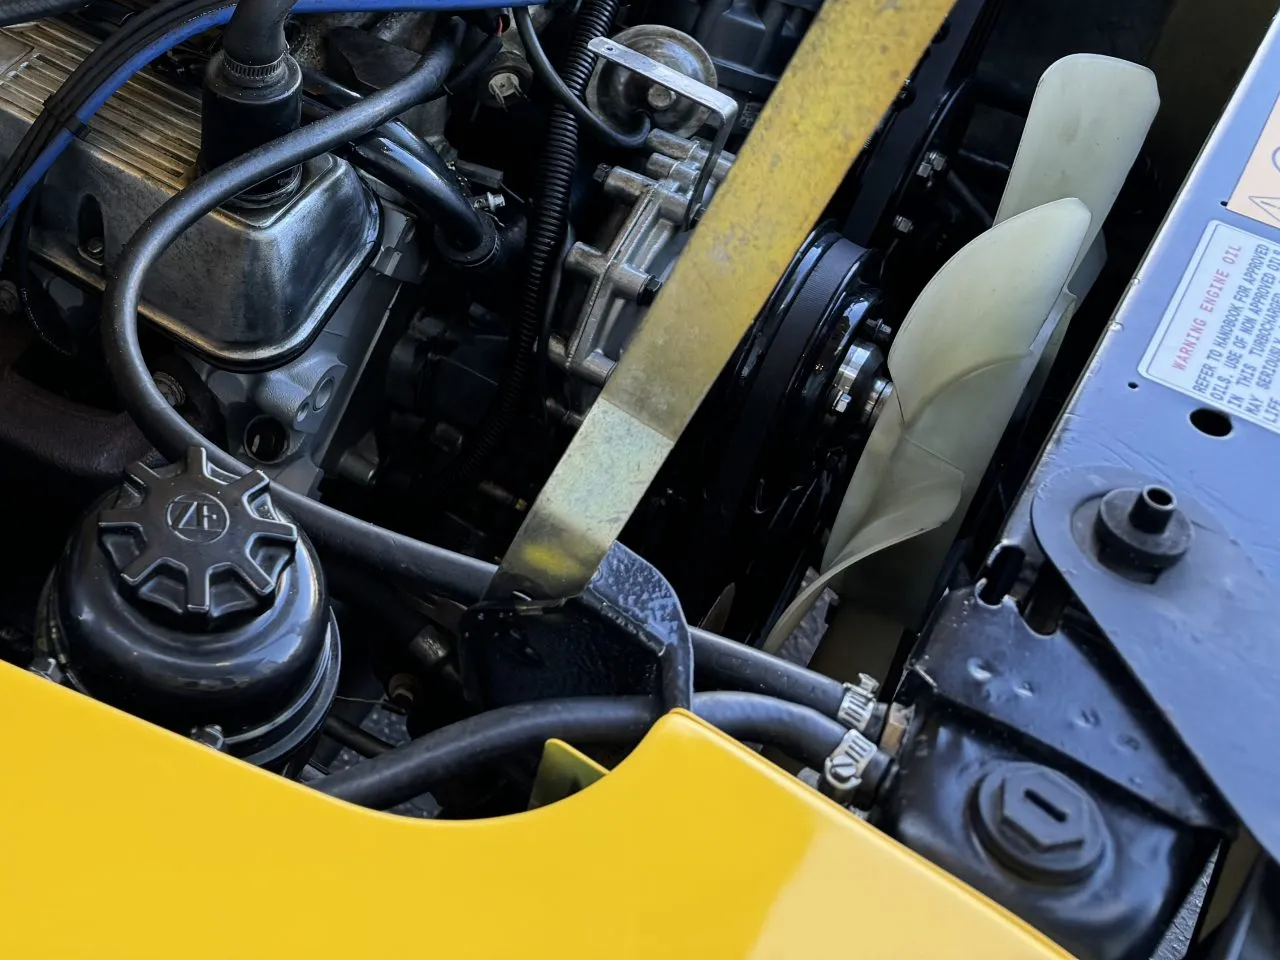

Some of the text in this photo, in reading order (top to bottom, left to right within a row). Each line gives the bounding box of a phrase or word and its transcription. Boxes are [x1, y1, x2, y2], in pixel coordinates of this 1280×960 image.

[1248, 272, 1277, 317] APPROVED
[1172, 245, 1242, 371] WARNING ENGINE OIL
[1192, 244, 1270, 394] REFER TO HANDBOOK FOR APPROVED
[1240, 317, 1258, 336] NON
[1233, 335, 1248, 350] OF
[1224, 351, 1243, 369] USE
[1210, 375, 1235, 401] OILS.
[1228, 395, 1244, 408] IN
[1236, 362, 1257, 388] THIS
[1245, 394, 1264, 416] MAY
